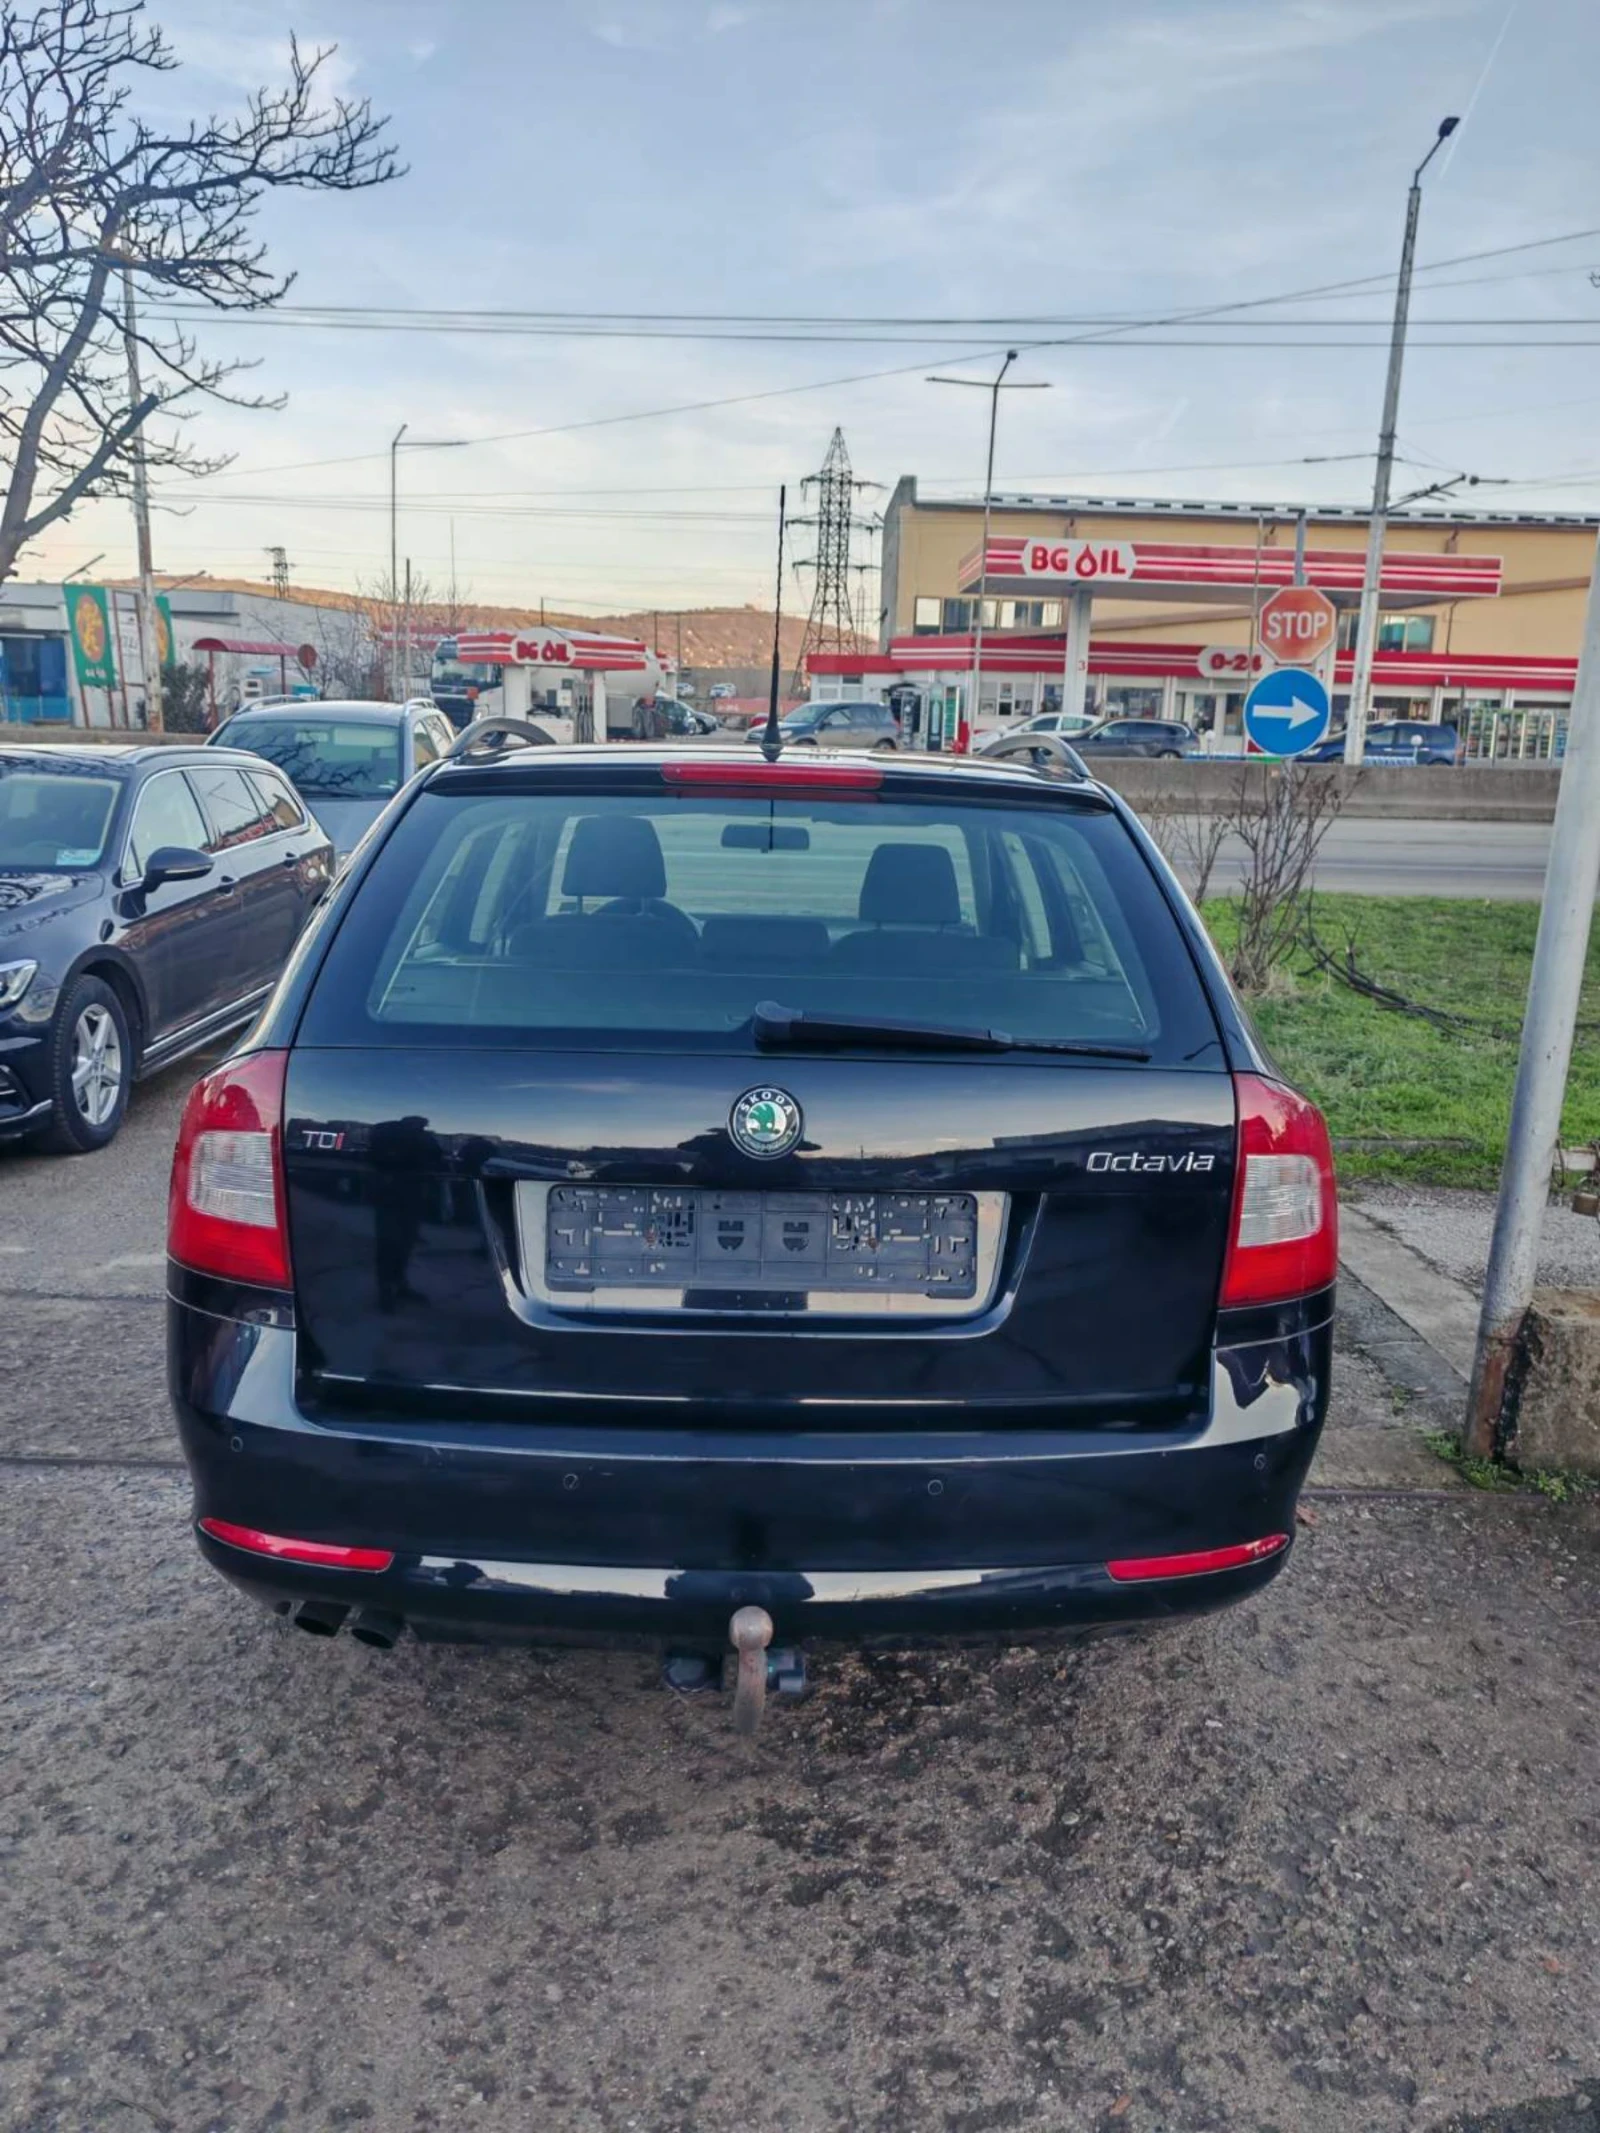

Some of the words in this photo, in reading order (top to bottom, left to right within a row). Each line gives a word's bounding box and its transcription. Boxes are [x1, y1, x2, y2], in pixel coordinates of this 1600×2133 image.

[1031, 546, 1069, 572] BG
[1075, 544, 1126, 577] OIL
[1266, 611, 1328, 640] STOP
[1086, 1151, 1216, 1173] Octavia
